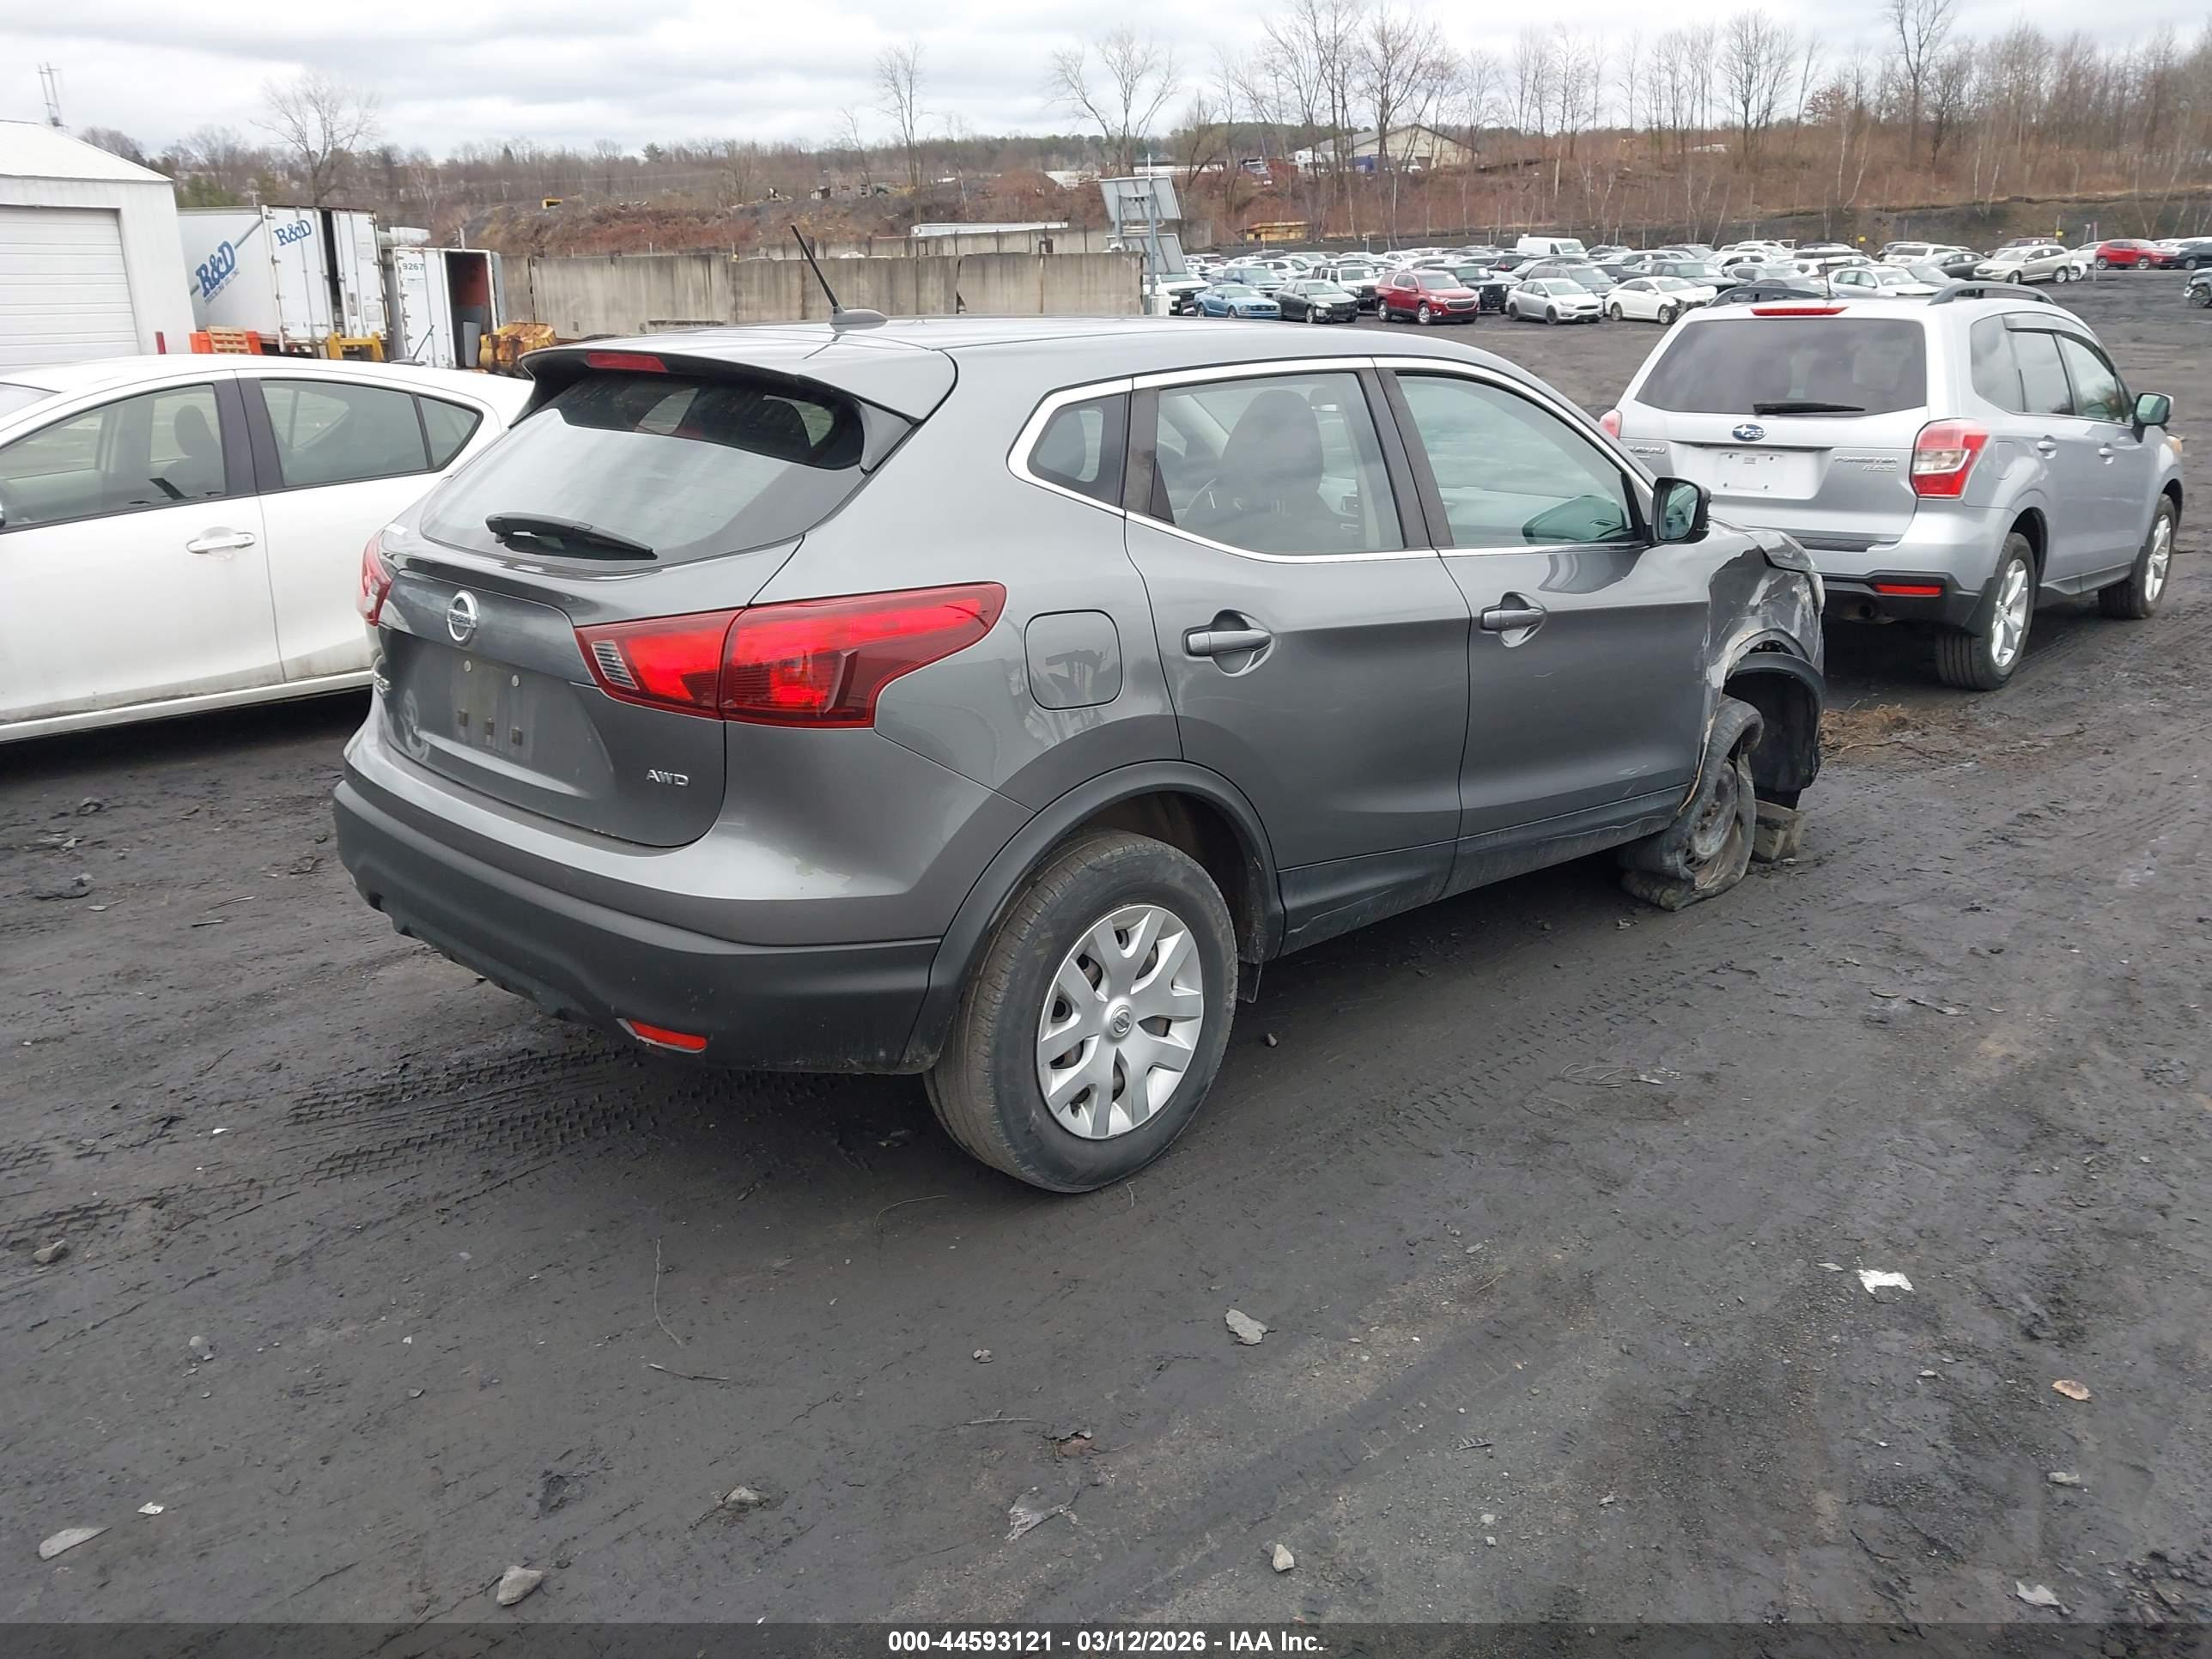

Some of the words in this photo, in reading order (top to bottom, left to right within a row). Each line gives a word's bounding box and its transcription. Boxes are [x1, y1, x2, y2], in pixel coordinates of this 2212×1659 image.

[273, 219, 312, 246] R&D
[195, 240, 235, 298] R&D
[646, 769, 689, 787] AWD
